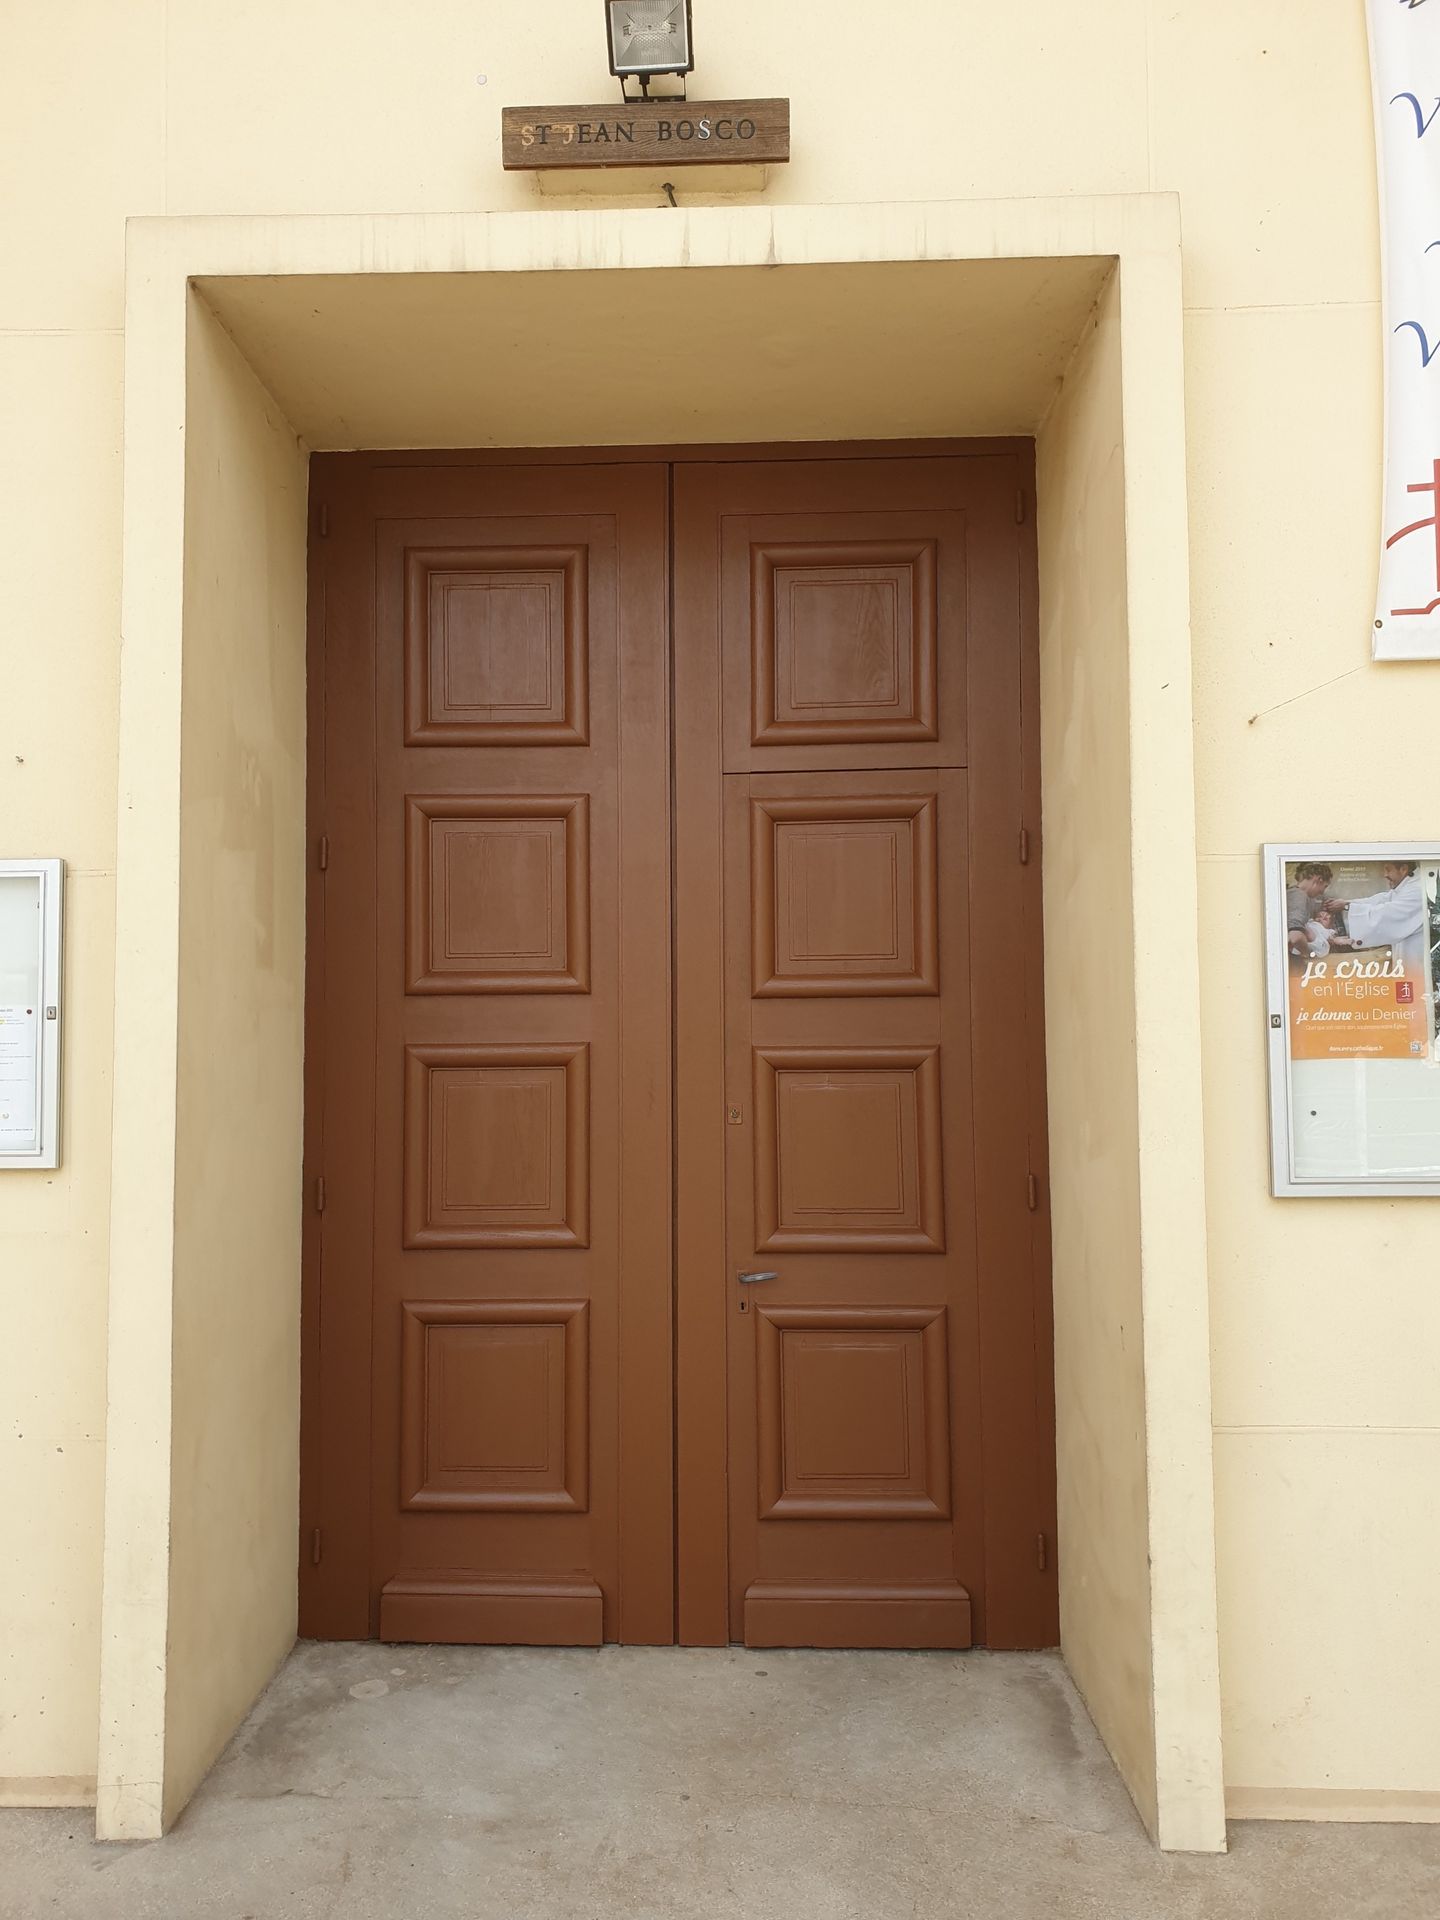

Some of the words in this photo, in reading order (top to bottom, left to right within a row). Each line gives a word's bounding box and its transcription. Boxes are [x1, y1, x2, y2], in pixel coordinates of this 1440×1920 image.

[521, 124, 552, 146] ST
[560, 121, 635, 145] JEAN
[657, 118, 756, 141] BOSCO
[1301, 951, 1328, 988] je
[1333, 950, 1405, 979] crois
[1313, 985, 1333, 997] en
[1336, 979, 1390, 1000] l'Église
[1296, 1007, 1309, 1025] je
[1311, 1007, 1352, 1021] donne
[1354, 1010, 1369, 1021] au
[1372, 1007, 1417, 1021] Denier
